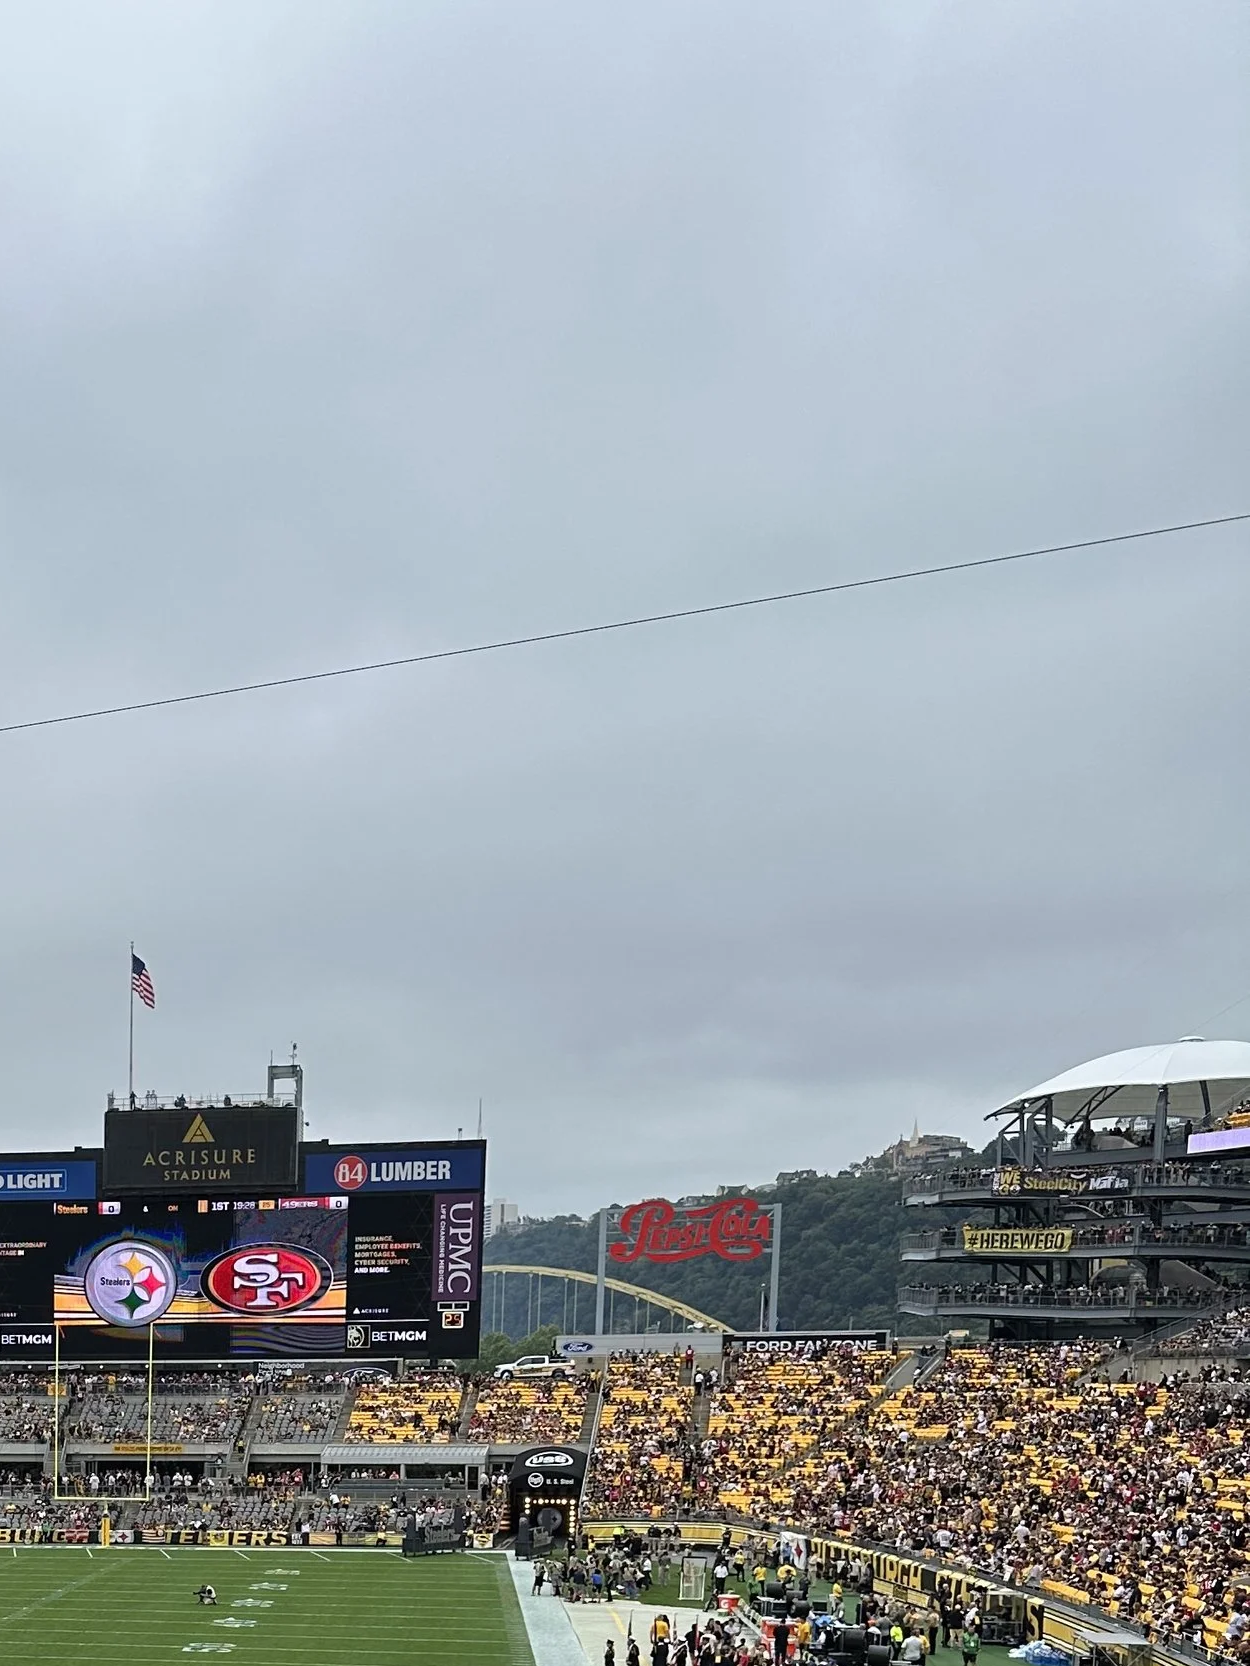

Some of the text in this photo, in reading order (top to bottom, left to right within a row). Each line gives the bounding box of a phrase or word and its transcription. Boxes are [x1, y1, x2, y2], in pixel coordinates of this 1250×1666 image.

[143, 1149, 256, 1167] ACRISURE
[164, 1168, 231, 1181] STADIUM
[337, 1159, 451, 1183] 84 LUMBER
[1000, 1171, 1021, 1184] WE
[7, 1173, 63, 1189] LIGHT
[57, 1204, 89, 1214] Steelers
[211, 1201, 230, 1211] 1ST
[233, 1201, 256, 1210] 19:28
[447, 1201, 473, 1294] UPMC
[967, 1231, 1066, 1251] #HEREWEGO
[100, 1276, 131, 1286] Steelers
[233, 1253, 303, 1306] SF
[1, 1334, 52, 1345] BETMGM
[371, 1330, 427, 1342] BETMGM
[746, 1341, 792, 1352] FORD
[258, 1362, 305, 1371] Neighborhood
